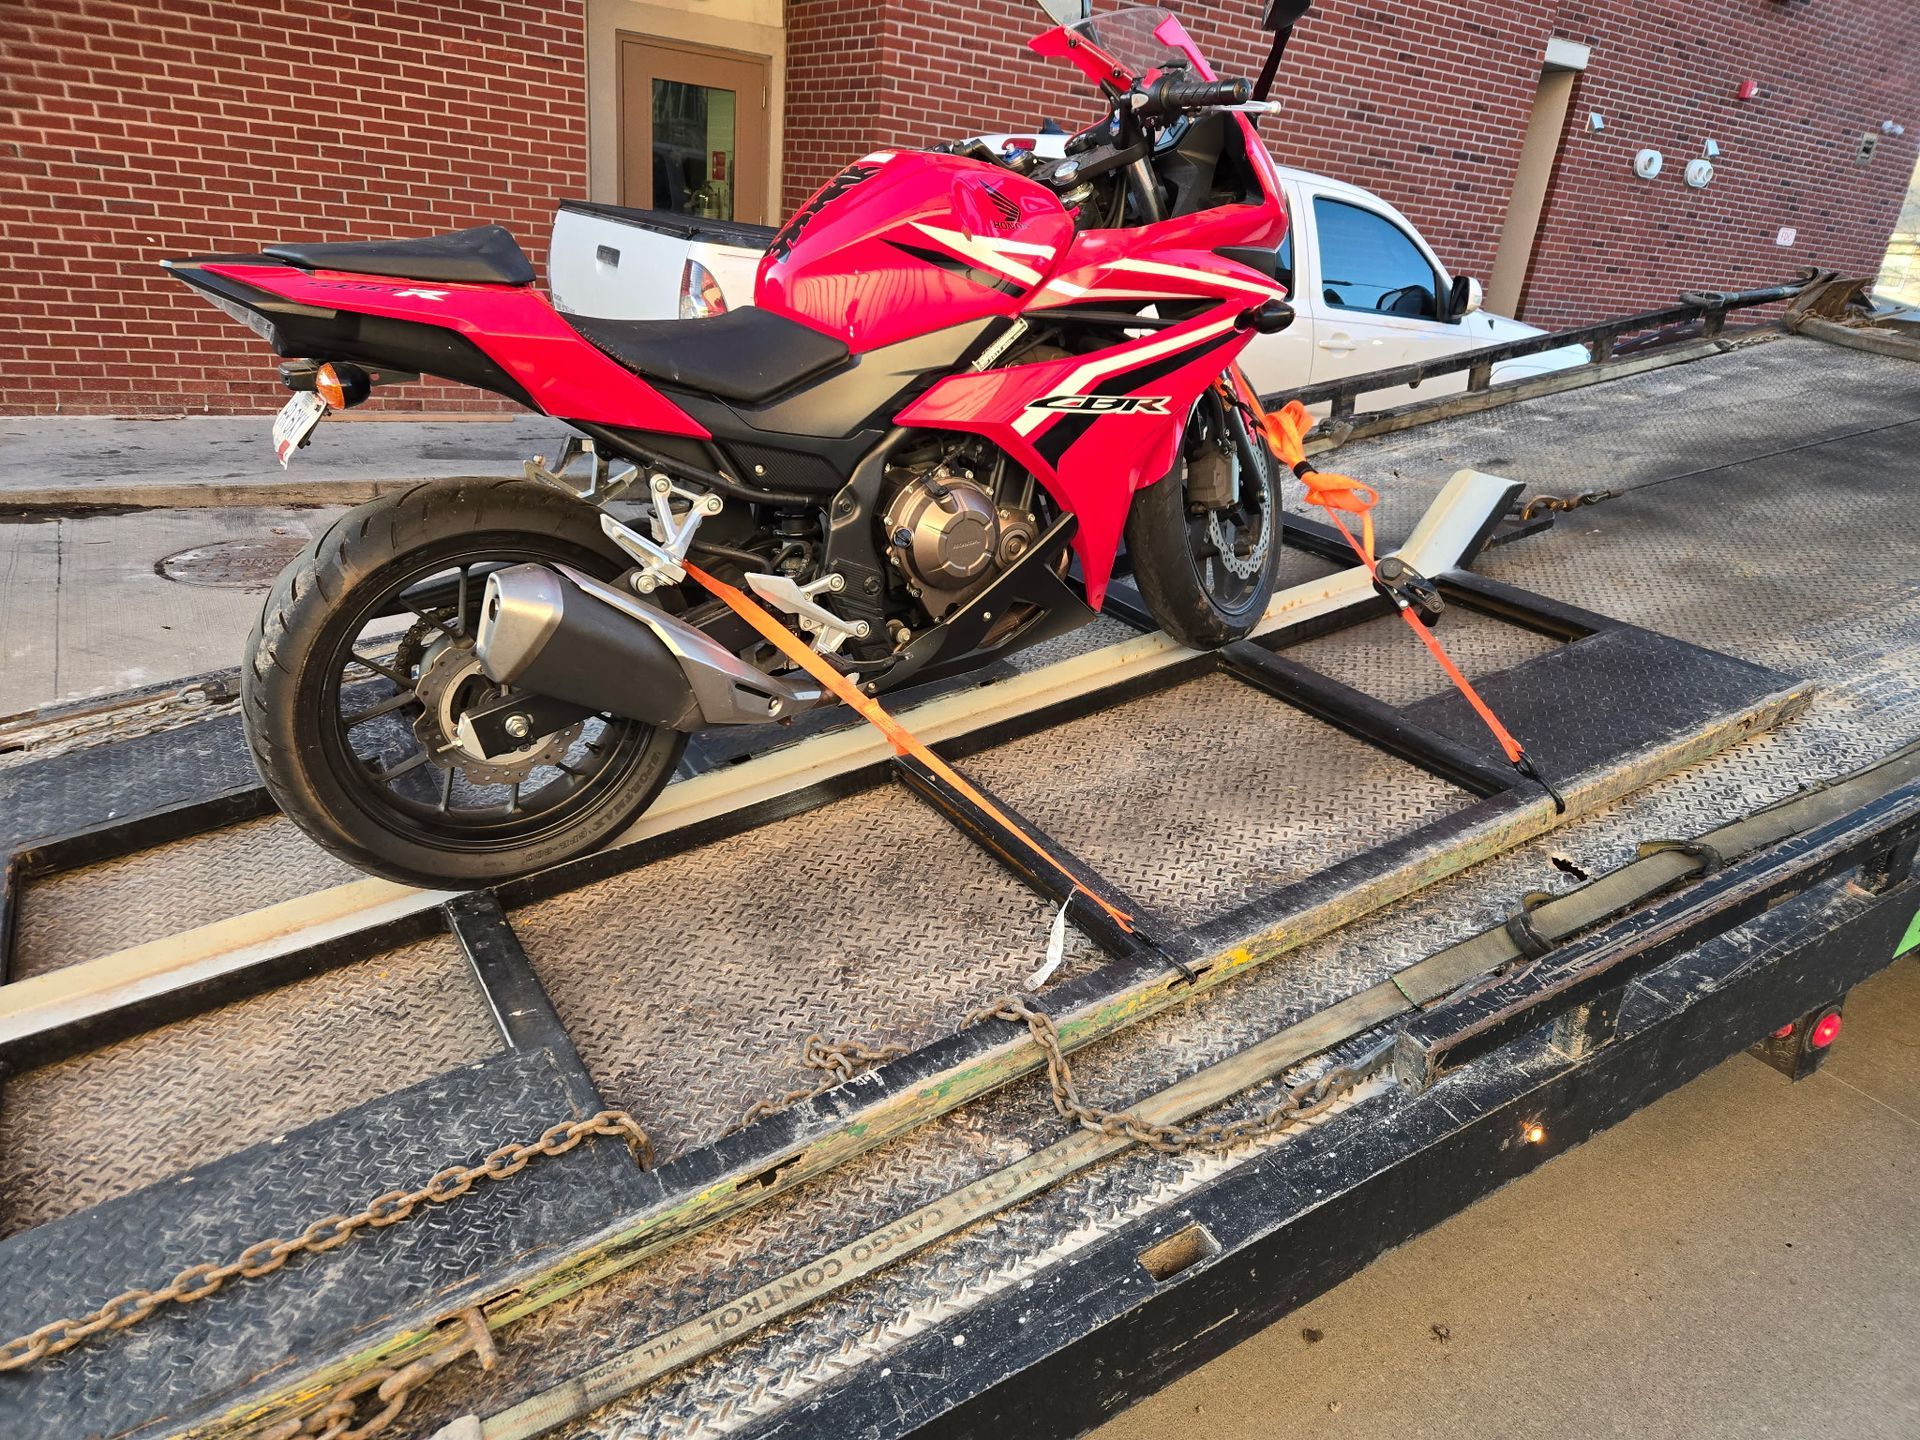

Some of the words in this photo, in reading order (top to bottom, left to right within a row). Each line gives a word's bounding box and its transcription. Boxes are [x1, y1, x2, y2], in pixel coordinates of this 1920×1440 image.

[1024, 395, 1172, 415] CBR
[850, 1208, 944, 1264] CARGO
[701, 1257, 843, 1335] CONTROL
[643, 1336, 685, 1359] WLL
